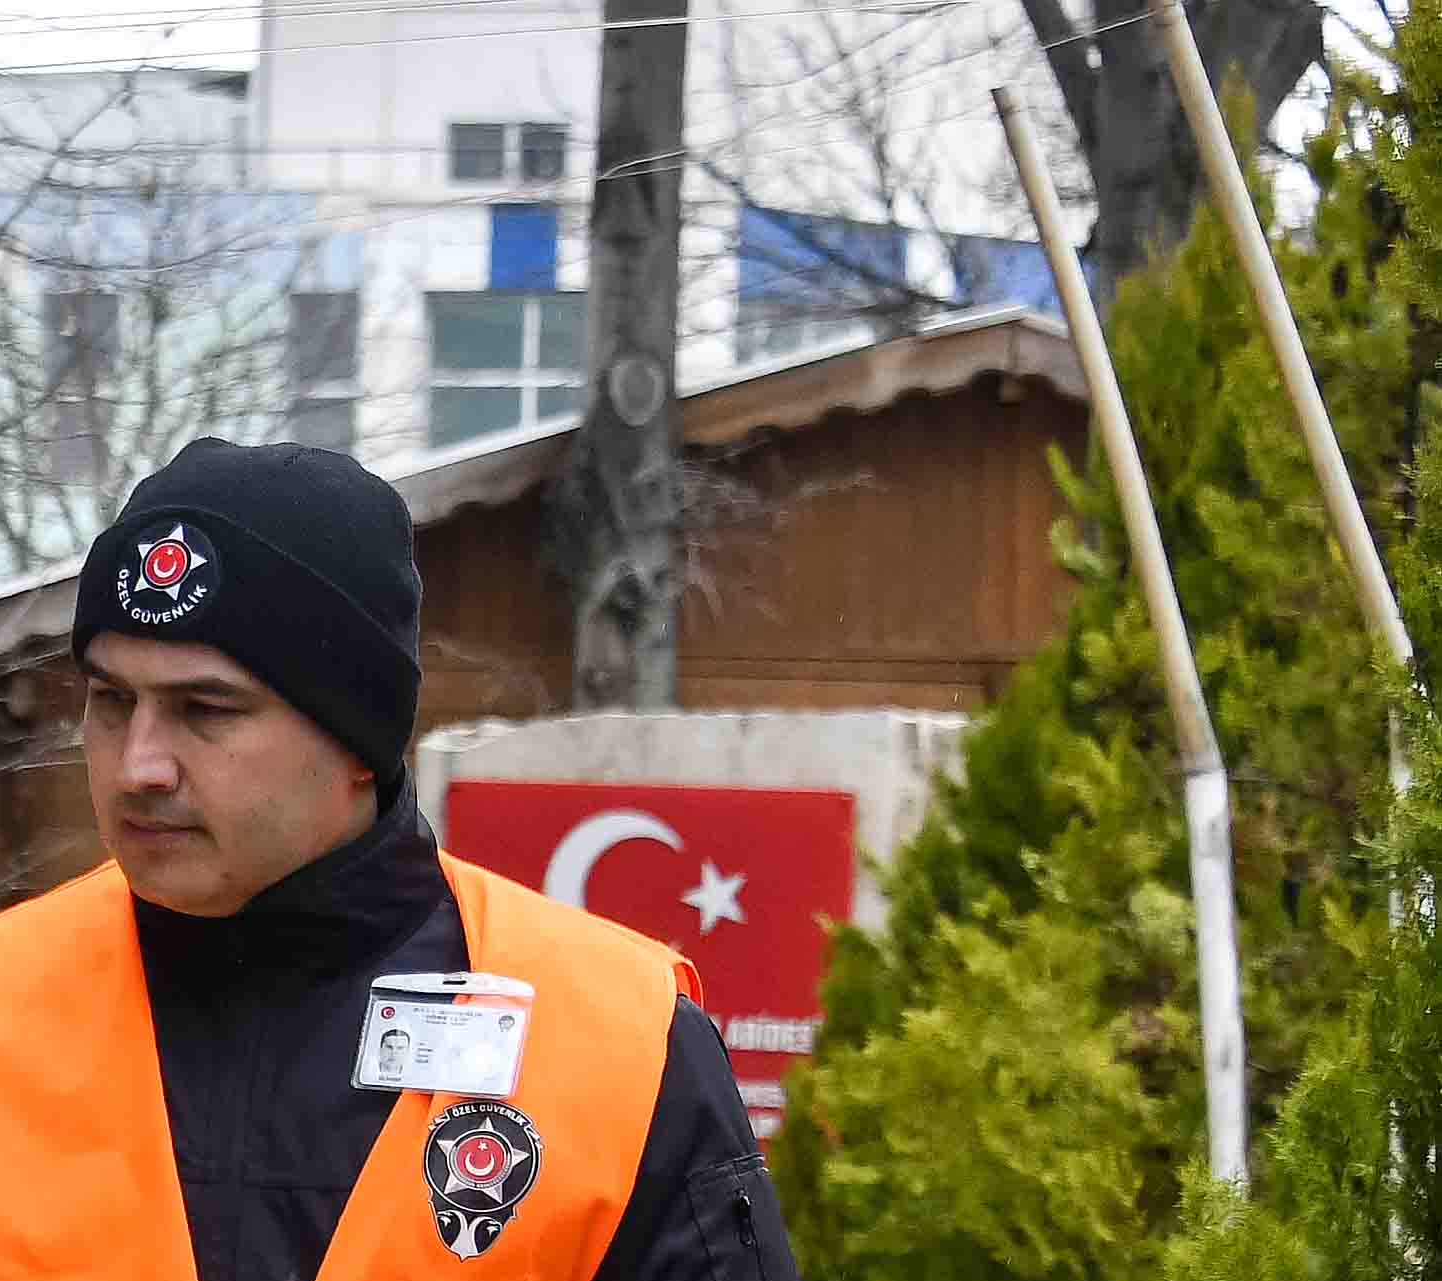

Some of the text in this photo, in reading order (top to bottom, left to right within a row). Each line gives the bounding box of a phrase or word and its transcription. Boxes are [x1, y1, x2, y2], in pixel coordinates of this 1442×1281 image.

[117, 566, 208, 624] ÖZEL GÜVENLİK
[452, 1104, 477, 1117] ÖZEL
